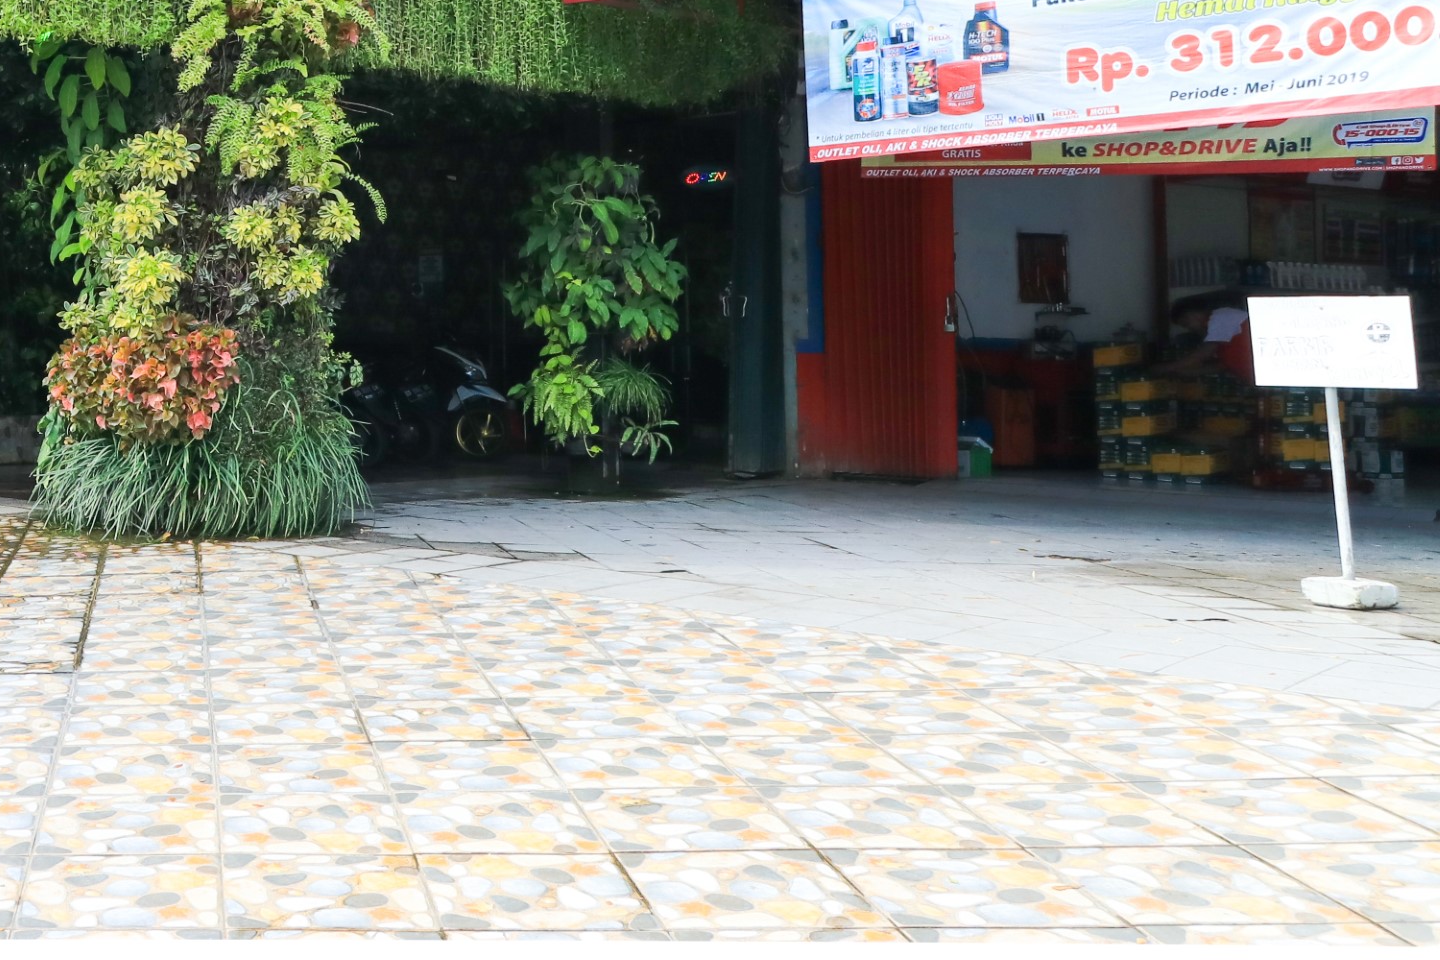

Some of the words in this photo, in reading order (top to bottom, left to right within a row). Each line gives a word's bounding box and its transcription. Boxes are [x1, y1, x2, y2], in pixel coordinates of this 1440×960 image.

[972, 52, 1004, 61] MOTUL
[1066, 46, 1149, 92] Rp.
[1169, 84, 1228, 102] Periode
[1244, 79, 1275, 95] Mei
[1287, 73, 1323, 92] Juni
[1326, 71, 1370, 87] 2019
[1089, 107, 1117, 116] MOTUL
[1009, 113, 1035, 124] Mobil
[822, 133, 843, 142] Untuk
[845, 130, 885, 141] pembelian
[923, 125, 938, 134] tipe
[940, 123, 973, 131] tertentu
[1345, 128, 1420, 138] 15-000-15
[817, 146, 859, 158] OUTLET
[862, 144, 883, 154] OLI,
[885, 141, 906, 153] AKI
[909, 141, 918, 150] &
[920, 136, 962, 150] SHOCK
[964, 130, 1032, 145] ABSORBER
[1034, 123, 1118, 139] TERPERCAYA
[1062, 142, 1087, 157] ke
[1092, 138, 1257, 158] SHOP&DRIVE
[1263, 136, 1312, 158] Aja!!
[942, 149, 981, 158] GRATIS
[921, 168, 937, 176] AKI
[939, 168, 945, 176] &
[949, 168, 980, 176] SHOCK
[982, 167, 1035, 176] ABSORBER
[1037, 167, 1101, 177] TERPERCAYA
